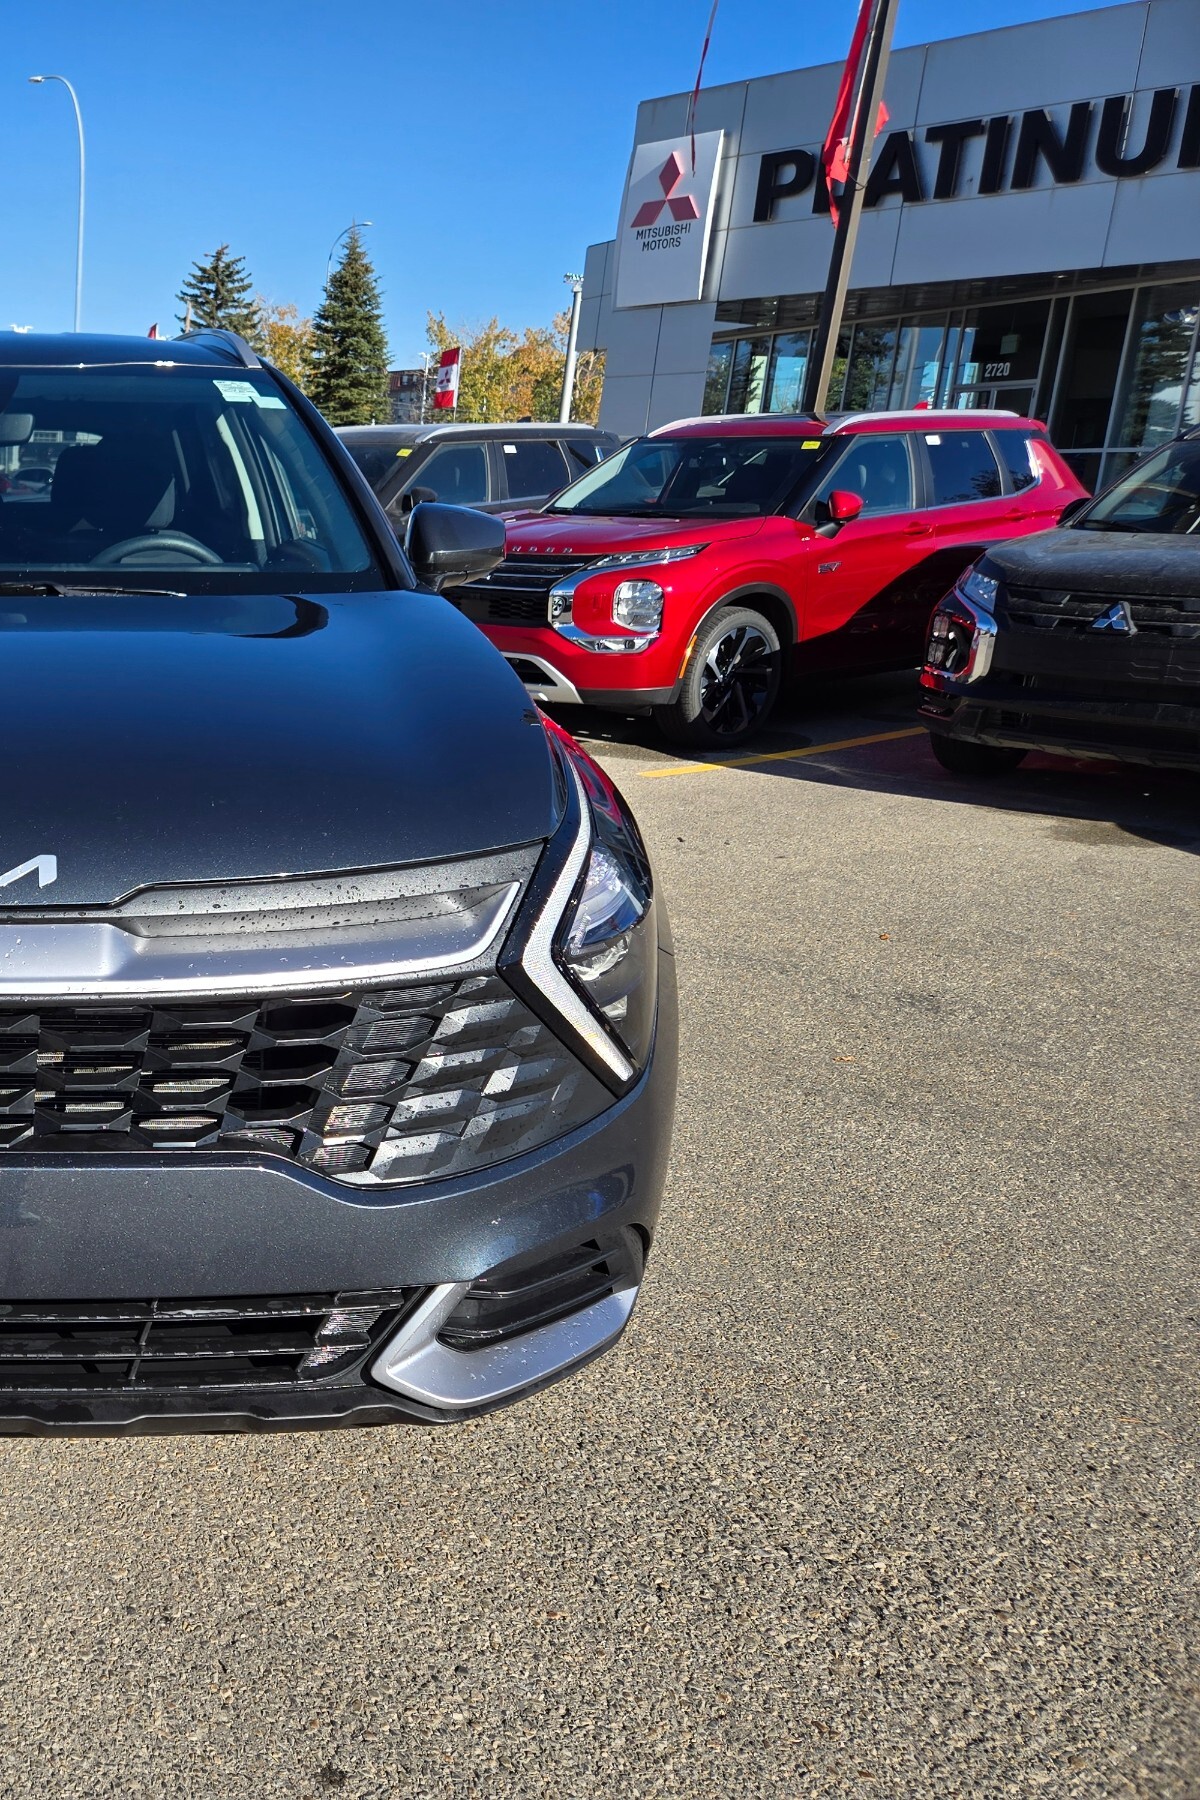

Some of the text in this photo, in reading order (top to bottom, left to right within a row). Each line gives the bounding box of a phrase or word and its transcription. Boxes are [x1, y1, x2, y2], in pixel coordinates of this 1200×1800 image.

[753, 84, 1200, 222] PLATINU
[635, 222, 692, 241] MITSUBISHI
[641, 236, 682, 252] MOTORS
[984, 362, 1011, 378] 2720
